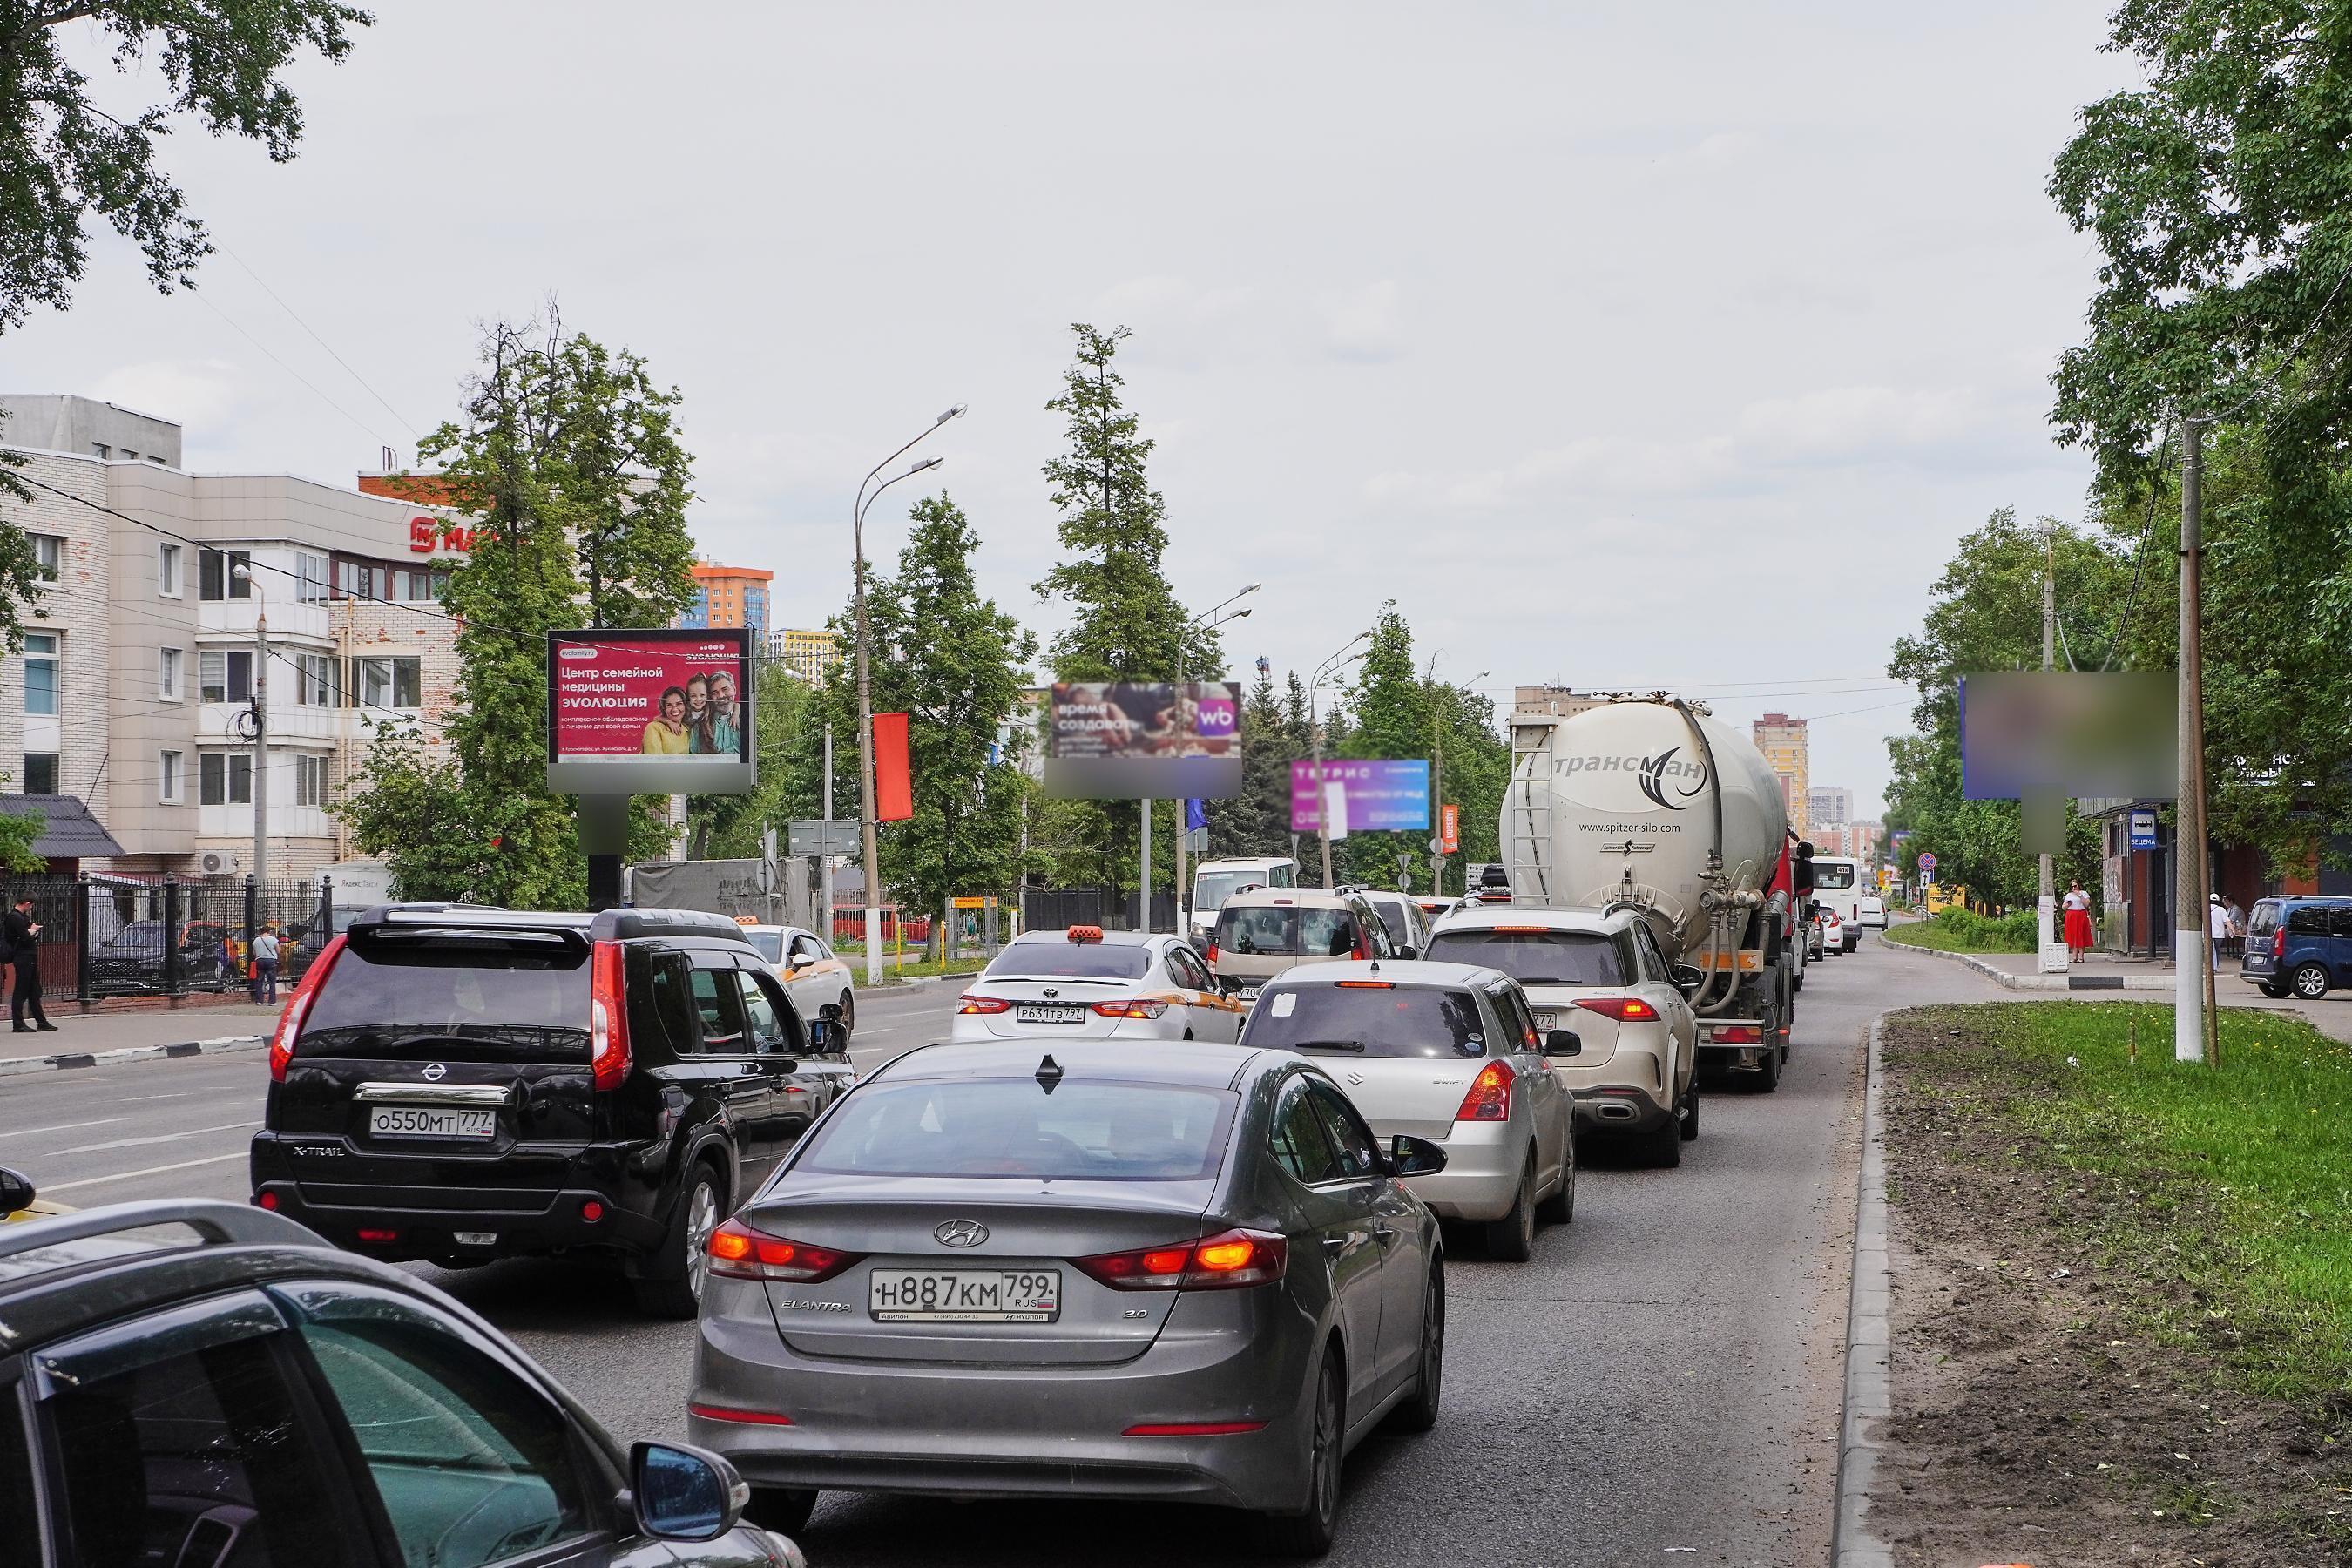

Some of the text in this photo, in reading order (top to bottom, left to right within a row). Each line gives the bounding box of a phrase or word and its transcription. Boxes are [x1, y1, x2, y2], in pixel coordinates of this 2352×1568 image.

[562, 667, 663, 679] Центр семейной
[562, 683, 625, 693] медицины
[1059, 704, 1107, 717] время
[1200, 706, 1233, 726] wb
[1296, 767, 1371, 779] ТЕТРИС
[1578, 822, 1680, 835] www.spitzer-silo.com
[1022, 1007, 1081, 1019] Р631ТВ 797
[376, 1110, 490, 1132] О550МТ 777
[293, 1146, 346, 1157] X-TRAIL
[881, 1274, 1049, 1306] Н887КМ 799
[781, 1300, 853, 1313] ELANTRA
[1015, 1299, 1037, 1308] RUS
